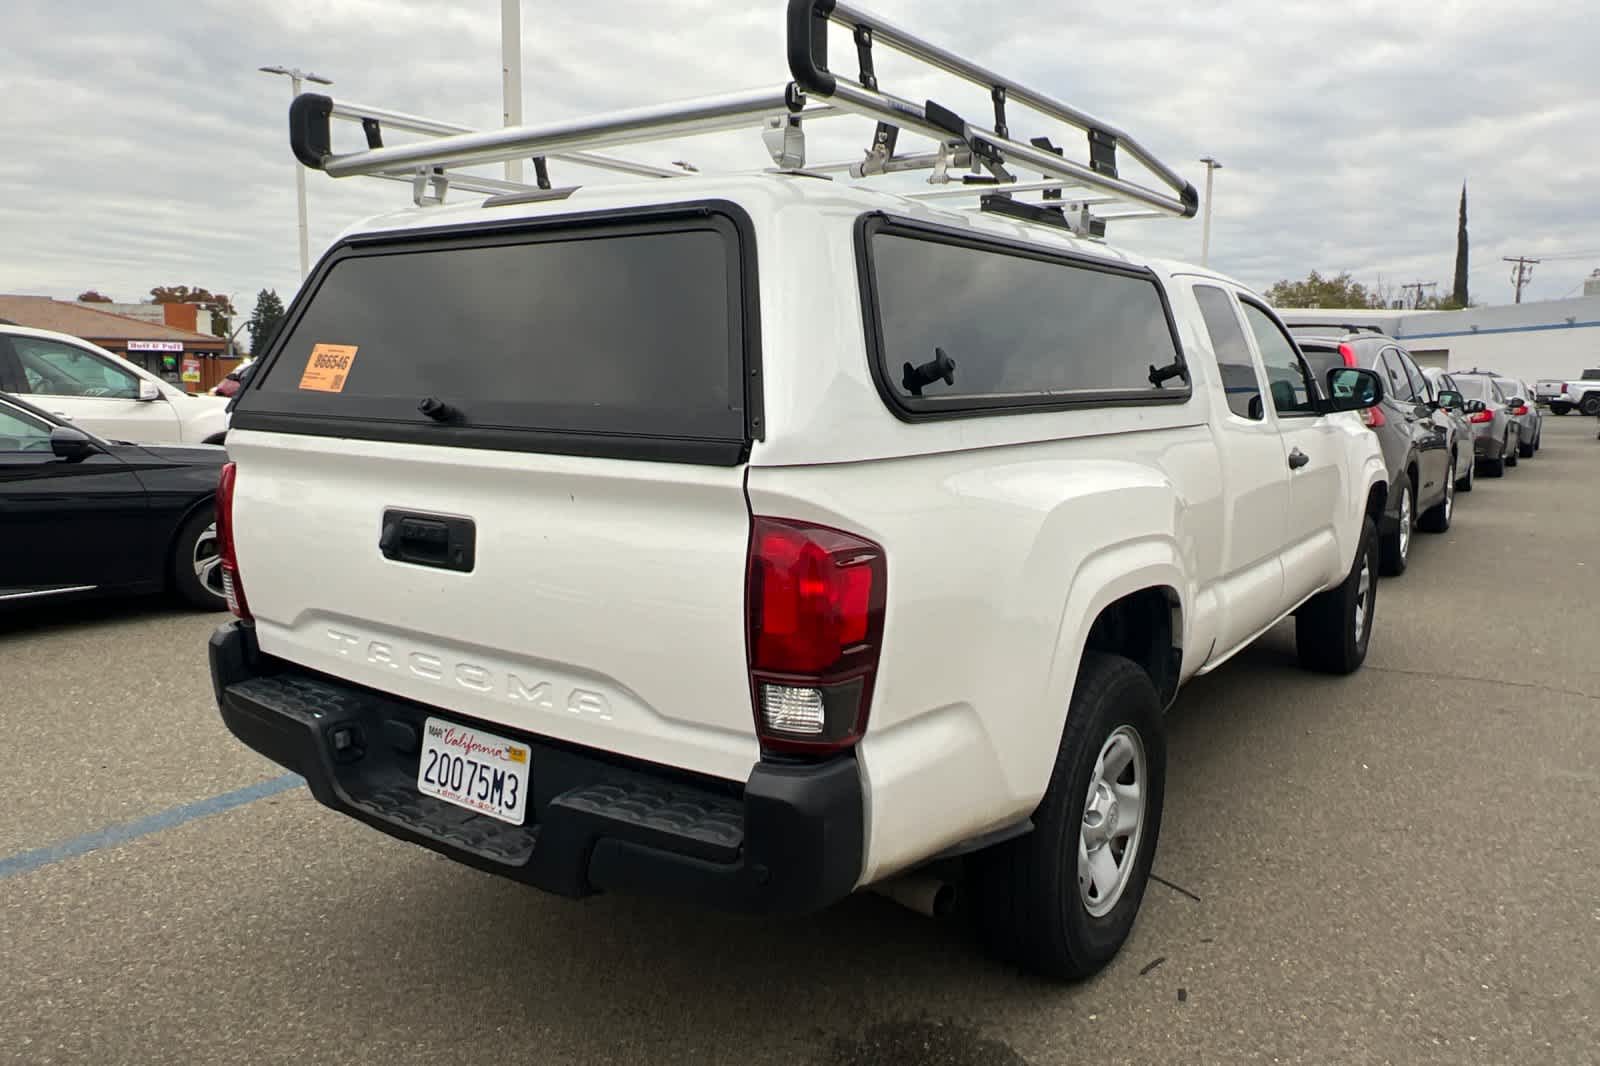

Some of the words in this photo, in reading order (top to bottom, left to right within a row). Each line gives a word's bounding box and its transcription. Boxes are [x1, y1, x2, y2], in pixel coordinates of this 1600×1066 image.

[327, 629, 613, 721] TACOMA
[428, 725, 443, 739] MAR
[444, 727, 508, 760] California
[424, 748, 519, 810] 20075M3
